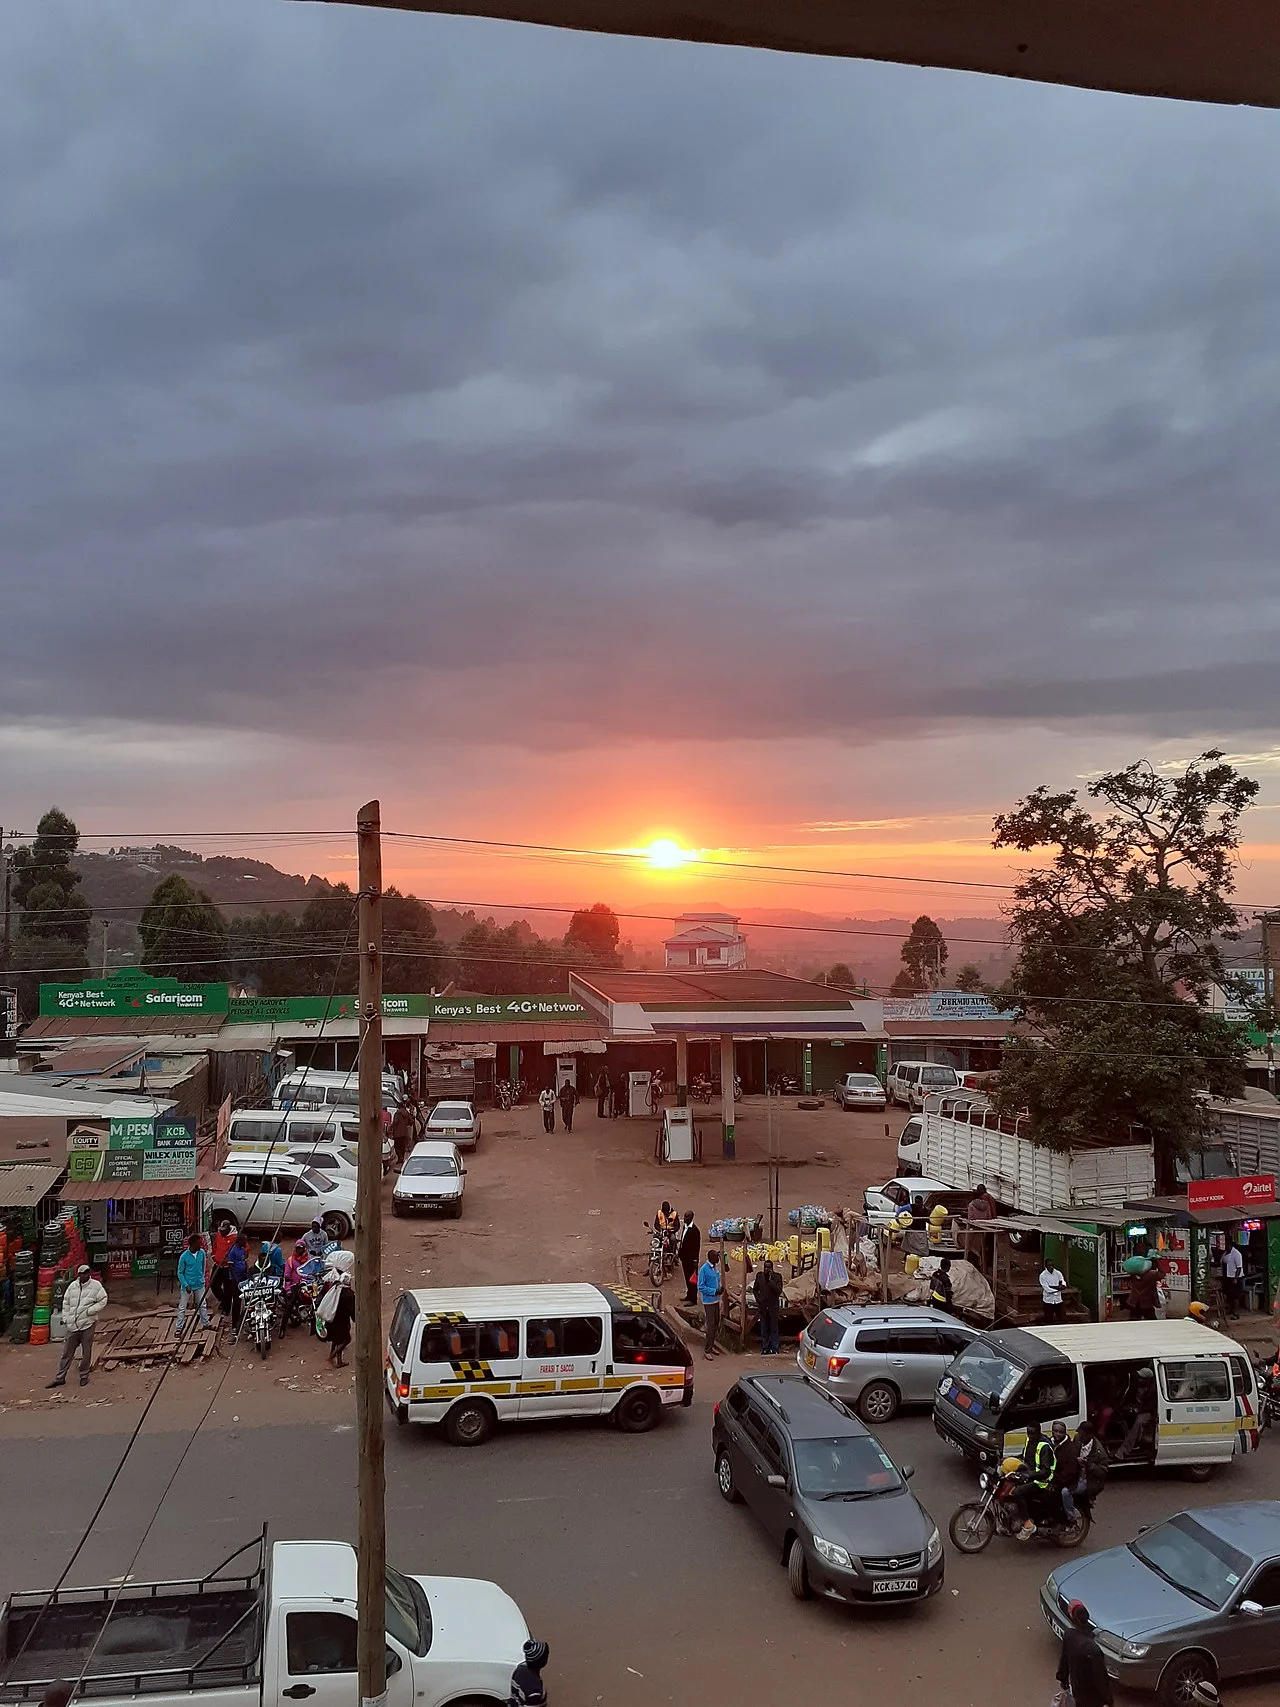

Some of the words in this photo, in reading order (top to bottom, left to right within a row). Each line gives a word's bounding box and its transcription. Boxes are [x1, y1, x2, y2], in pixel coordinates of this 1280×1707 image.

[58, 991, 84, 1000] Kenya's
[86, 990, 104, 998] Best
[146, 993, 203, 1003] Safaricom
[80, 999, 116, 1007] Network
[354, 999, 408, 1009] Sicom
[434, 1005, 472, 1017] Kenya's
[476, 1003, 501, 1014] Best
[127, 1124, 154, 1136] PESA
[166, 1127, 185, 1136] KCB
[145, 1152, 170, 1160] WILEX
[1253, 1182, 1272, 1193] airtel
